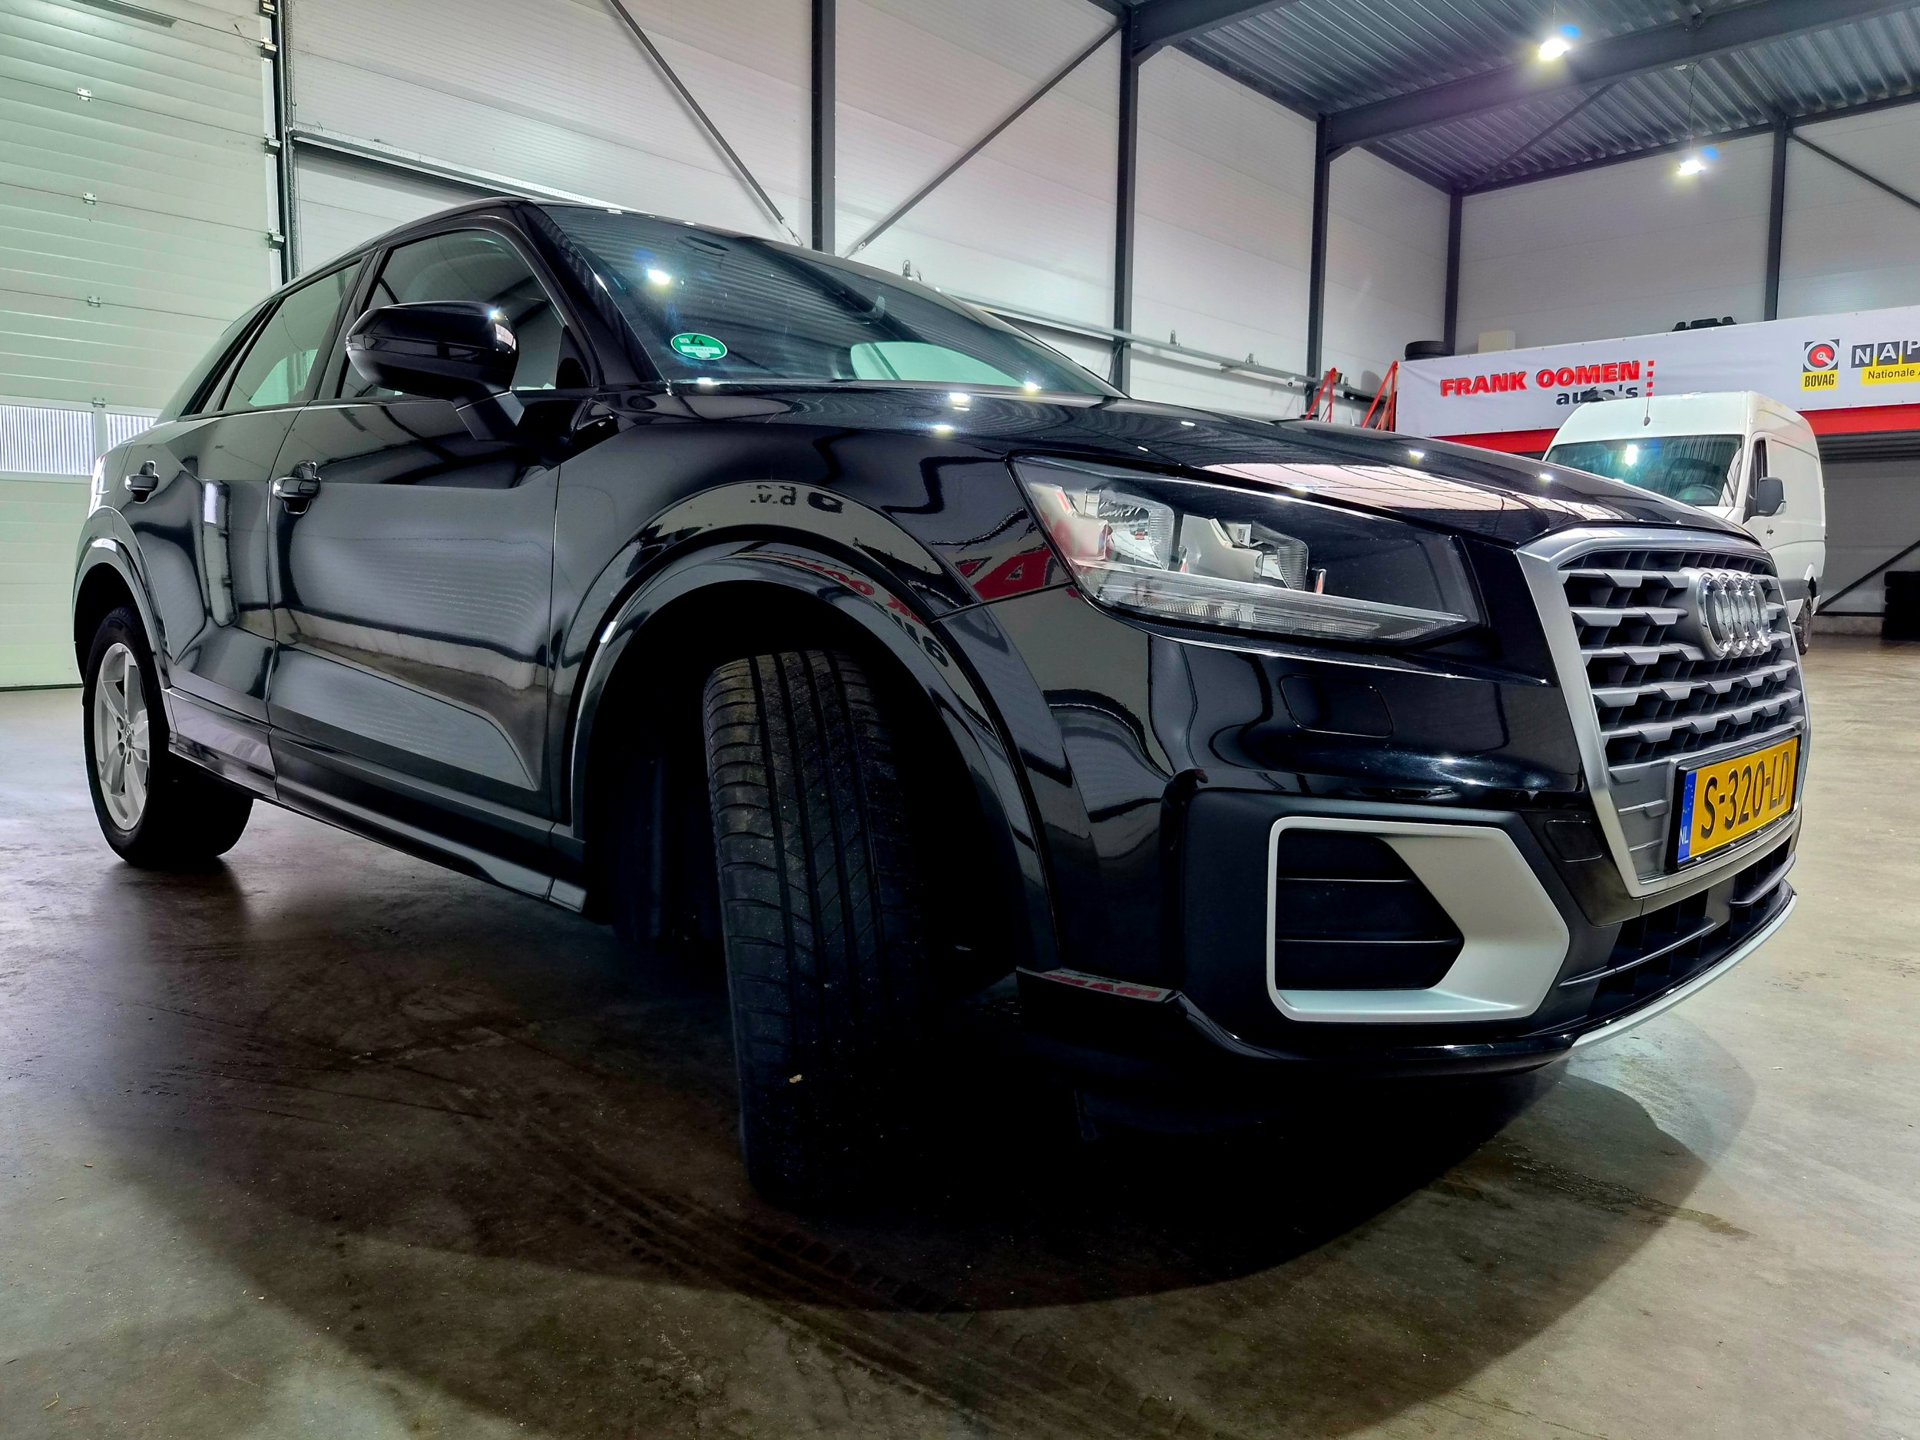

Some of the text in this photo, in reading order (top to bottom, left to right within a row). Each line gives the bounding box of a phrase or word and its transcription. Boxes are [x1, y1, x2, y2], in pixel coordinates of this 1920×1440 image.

[1855, 341, 1920, 365] NAP
[1440, 360, 1641, 397] FRANK OOMEN
[1804, 373, 1835, 387] BOVAG
[1868, 368, 1915, 379] Nationale
[1556, 385, 1638, 405] au's
[1700, 751, 1790, 839] S-320-LD
[1679, 826, 1689, 845] NL
